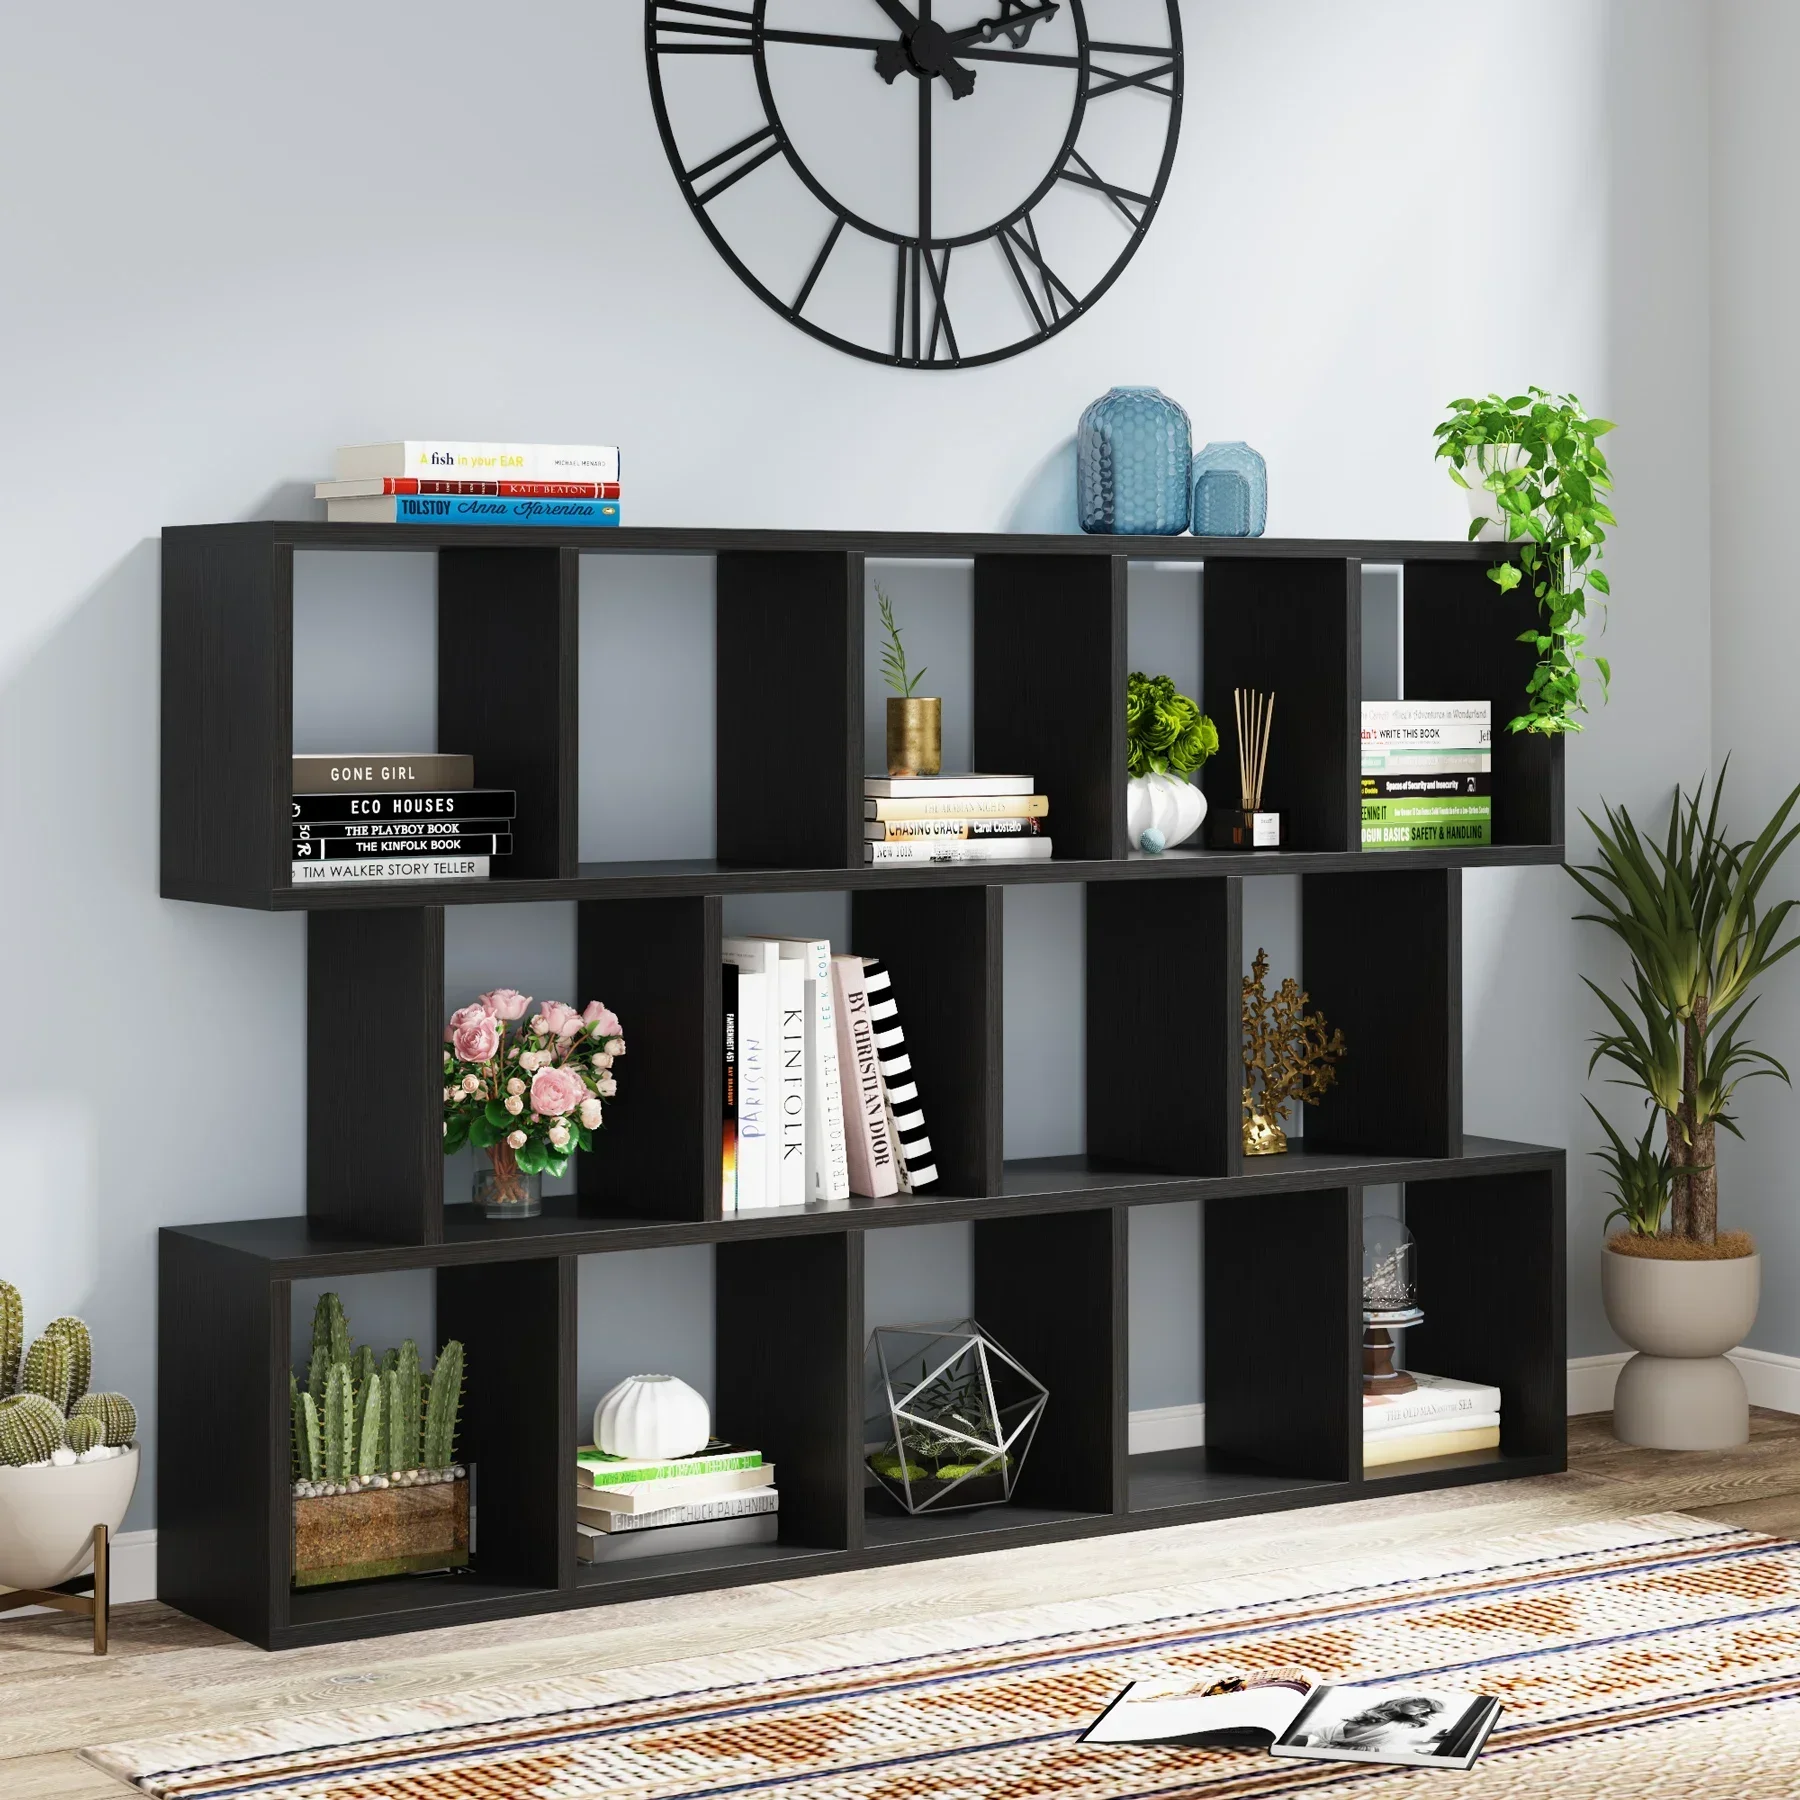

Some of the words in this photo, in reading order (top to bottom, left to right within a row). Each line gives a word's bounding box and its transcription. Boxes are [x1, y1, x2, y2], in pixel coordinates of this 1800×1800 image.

[420, 453, 428, 464] A
[431, 452, 454, 465] fish
[457, 453, 468, 465] in
[471, 456, 497, 468] your
[500, 455, 523, 467] EAR
[510, 485, 539, 494] KATE
[543, 485, 587, 495] BEATON
[402, 499, 450, 515] TOLSTOY
[458, 501, 508, 515] Anna
[513, 501, 595, 519] Karenina
[1378, 729, 1401, 739] WRITE
[1402, 729, 1418, 739] THIS
[1419, 729, 1440, 739] BOOK
[331, 767, 373, 782] GONE
[381, 766, 415, 781] GIRL
[1386, 781, 1403, 792] Spaces
[1408, 780, 1427, 791] Security
[1436, 780, 1459, 791] Insecurity
[351, 800, 381, 815] ECO
[393, 798, 454, 813] HOUSES
[925, 803, 938, 814] THE
[941, 803, 975, 813] ARABIAN
[977, 802, 1006, 812] NIGHTS
[1381, 806, 1387, 820] IT
[345, 825, 370, 836] THE
[371, 824, 425, 836] PLAYBOY
[427, 823, 460, 835] BOOK
[889, 820, 931, 836] CHASING
[933, 819, 964, 835] GRACE
[993, 820, 1022, 833] Costello
[1384, 827, 1410, 842] BASICS
[1411, 827, 1437, 841] SAFETY
[1439, 826, 1445, 840] &
[1446, 825, 1482, 840] HANDLING
[356, 842, 378, 852] THE
[381, 840, 428, 852] KINFOLK
[430, 839, 461, 850] BOOK
[303, 866, 325, 879] TIM
[330, 864, 384, 878] WALKER
[388, 863, 430, 876] STORY
[434, 862, 475, 874] TELLER
[816, 944, 828, 978] COLE
[848, 991, 866, 1015] BY
[821, 1005, 832, 1029] LEE
[726, 1013, 735, 1051] FAHRENHEIT
[726, 1051, 735, 1063] 451
[853, 1022, 885, 1116] CHRISTIAN
[739, 1039, 766, 1139] PARISIAN
[783, 1009, 803, 1161] KINFOLK
[823, 1053, 846, 1191] TRANQUILITY
[869, 1117, 891, 1167] DIOR
[1386, 1409, 1402, 1422] THE
[1402, 1407, 1419, 1419] OLD
[1419, 1404, 1437, 1417] MAN
[1458, 1398, 1473, 1411] SEA
[679, 1505, 714, 1523] CHUCK
[717, 1497, 776, 1518] PALAHNIUK
